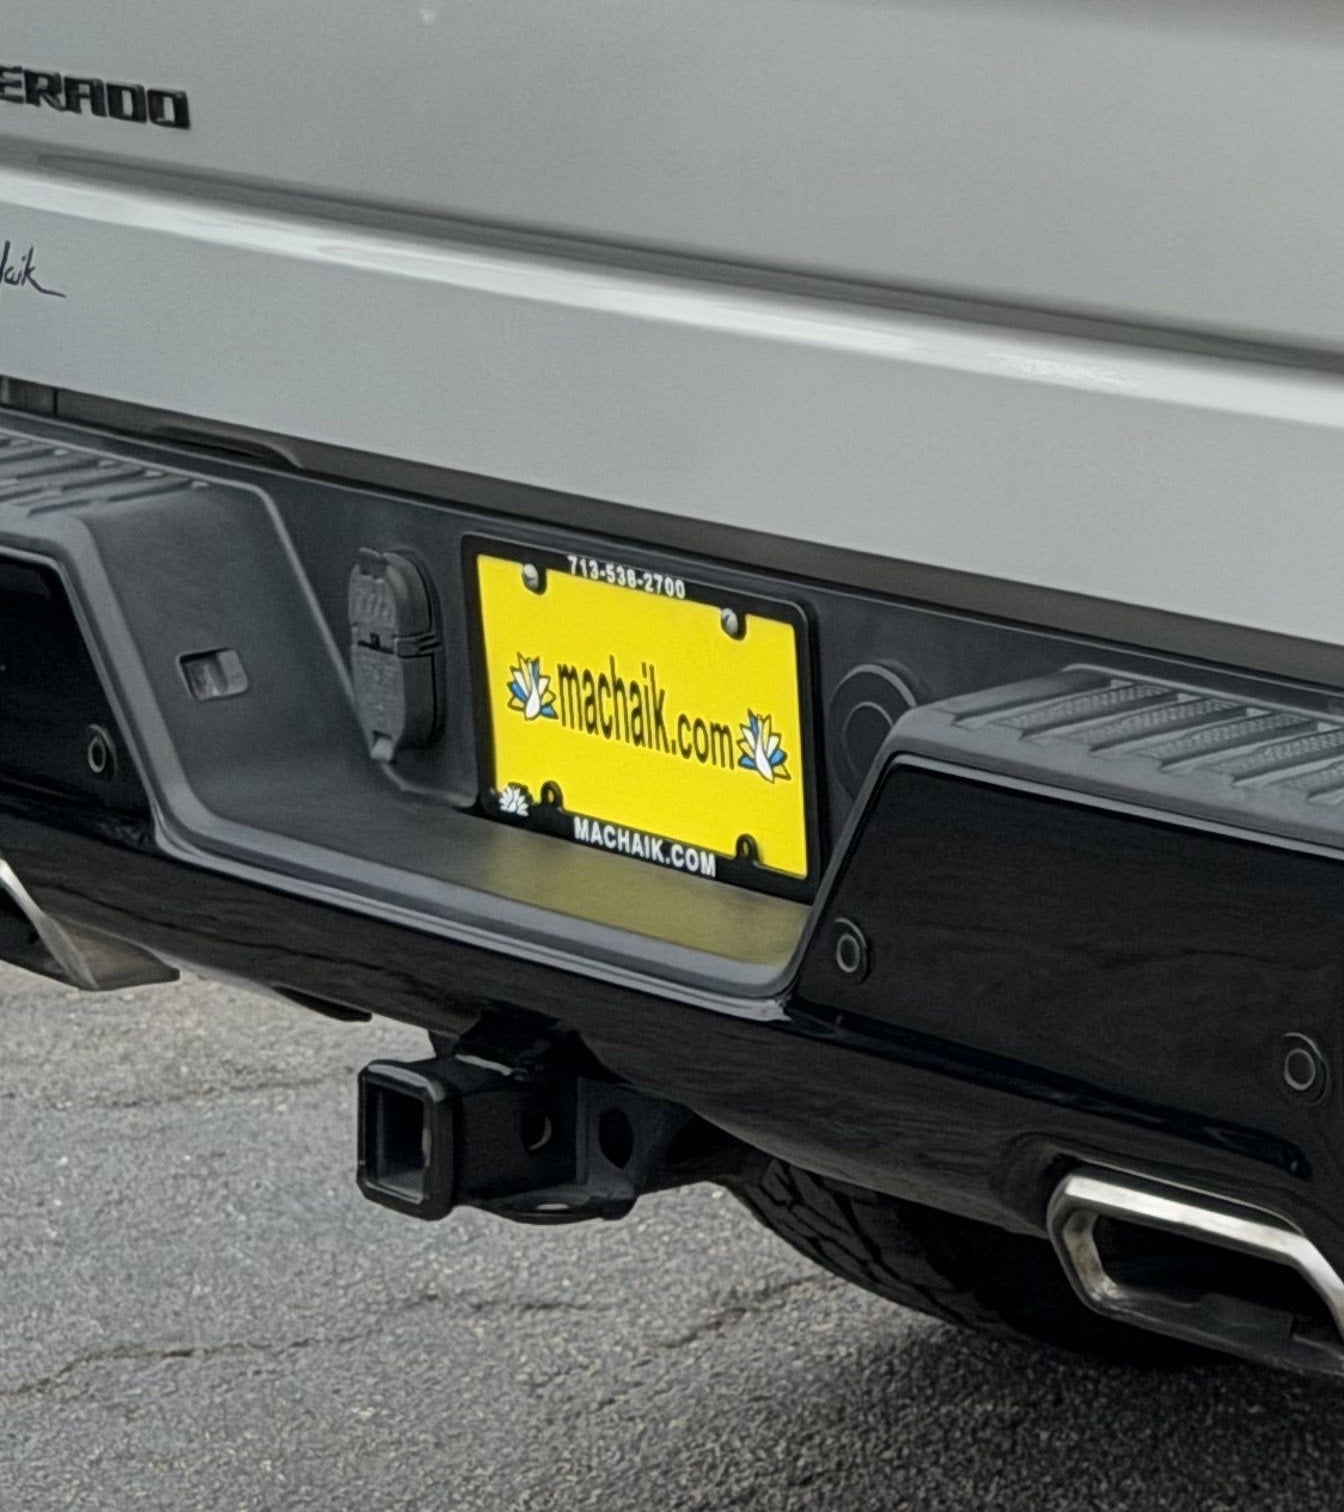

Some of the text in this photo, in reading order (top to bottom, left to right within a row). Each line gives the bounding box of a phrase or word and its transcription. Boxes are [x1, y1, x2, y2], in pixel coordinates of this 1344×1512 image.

[567, 554, 686, 599] 713-538-2700
[557, 654, 735, 770] machaik.com
[573, 816, 717, 878] MACHAIK.COM
